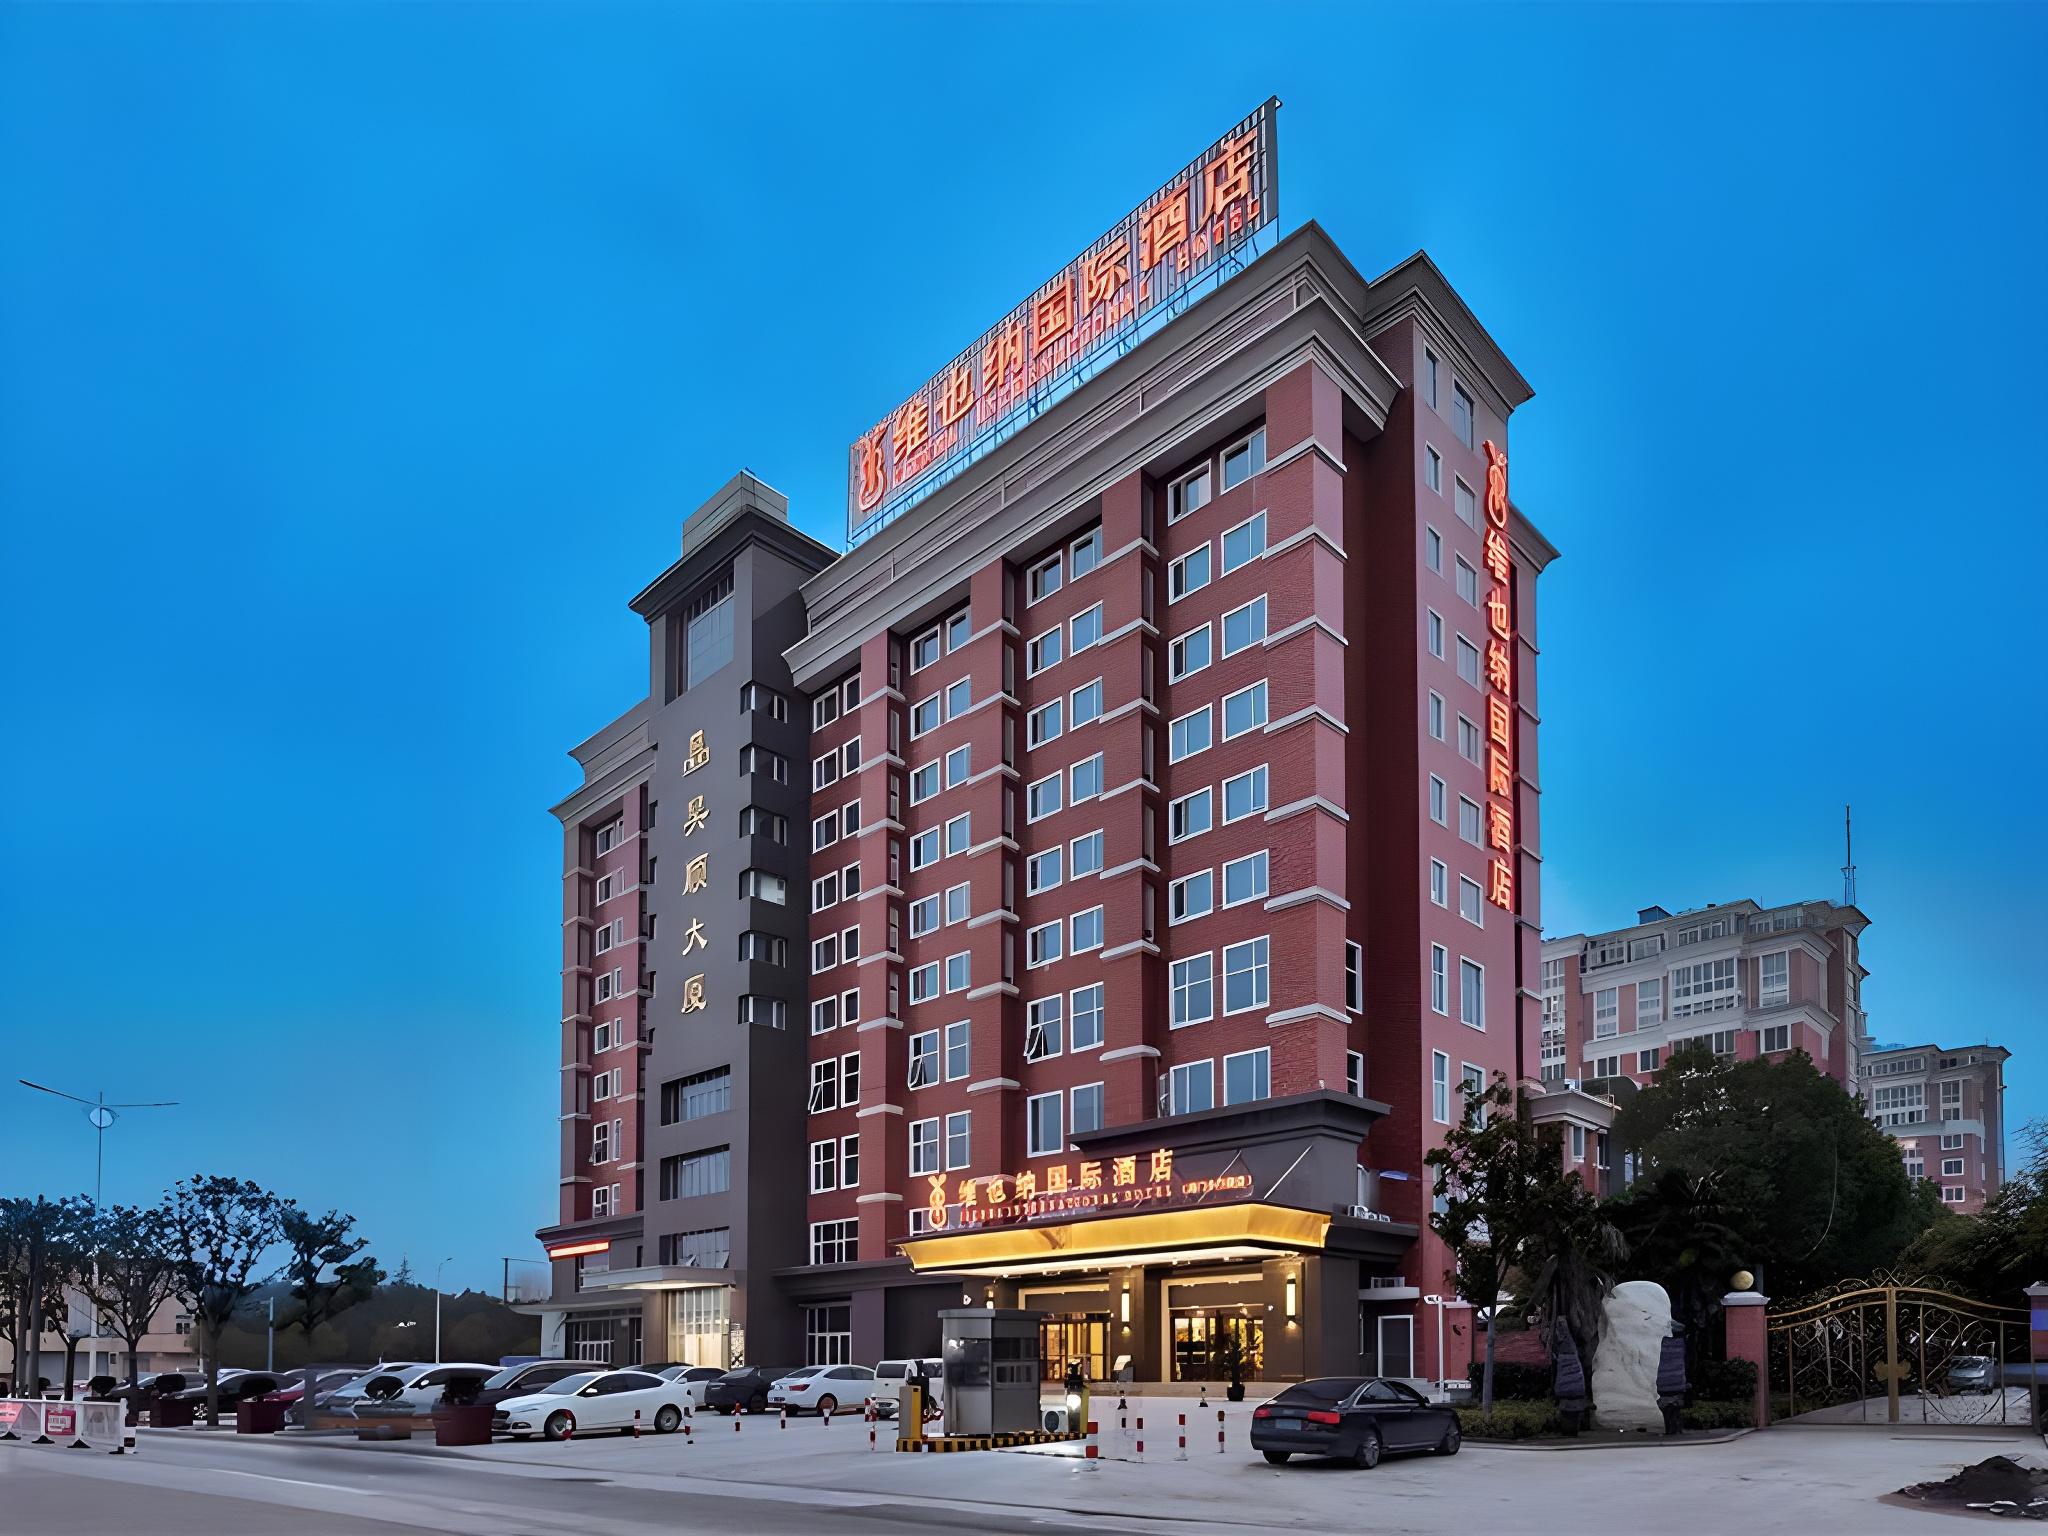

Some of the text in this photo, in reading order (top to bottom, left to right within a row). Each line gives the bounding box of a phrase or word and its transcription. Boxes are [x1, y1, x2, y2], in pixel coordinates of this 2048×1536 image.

[893, 126, 1258, 466] 维也纳国际酒店
[958, 1148, 1174, 1207] 维也纳国际酒店
